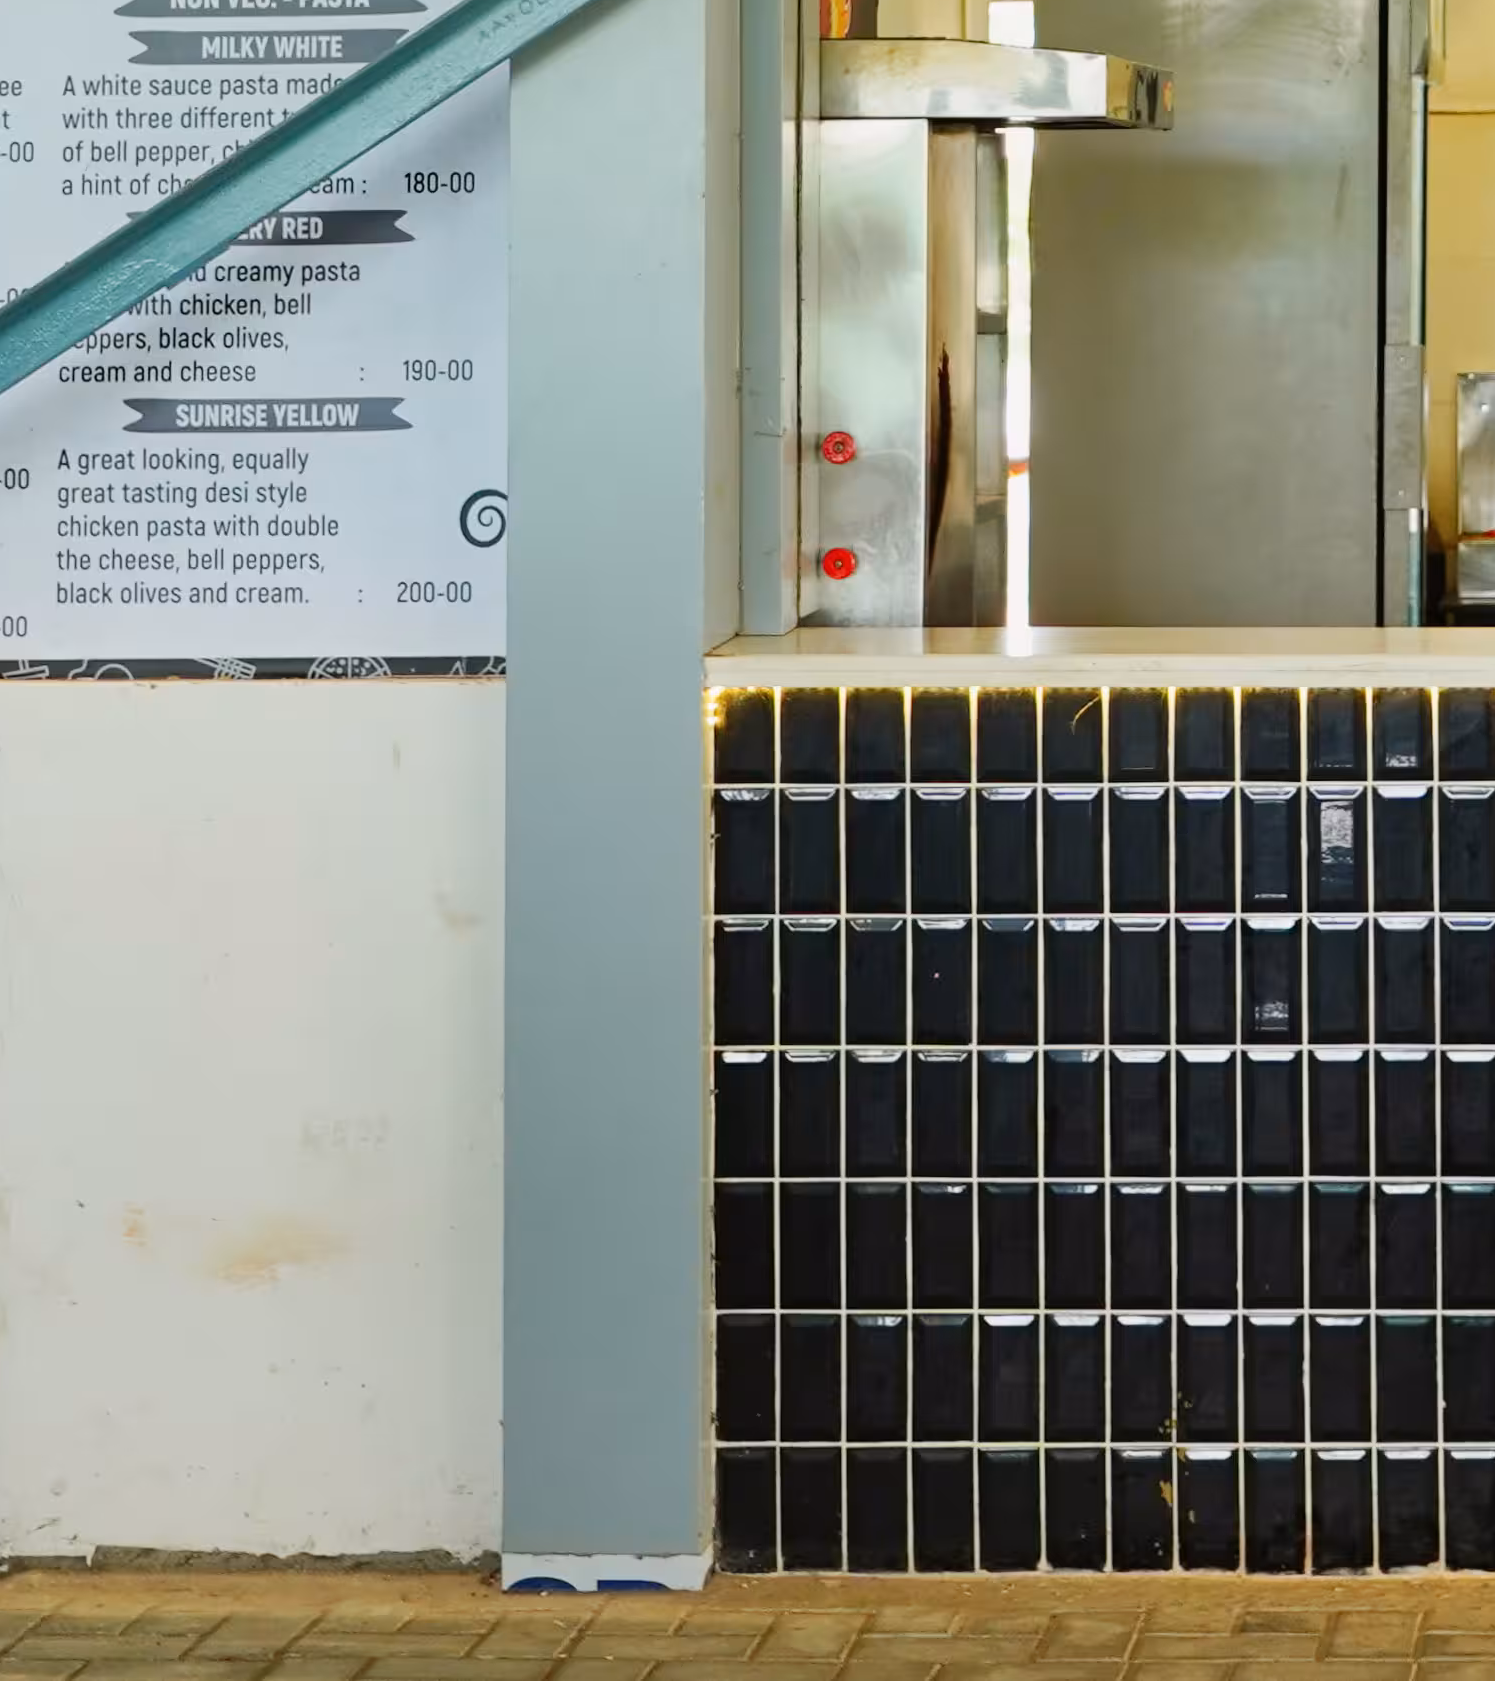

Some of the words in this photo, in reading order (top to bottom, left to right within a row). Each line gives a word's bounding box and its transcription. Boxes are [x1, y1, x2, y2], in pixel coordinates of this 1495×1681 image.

[175, 403, 268, 428] SUNRISE
[272, 403, 360, 427] YELLOW
[57, 514, 139, 537] chicken
[147, 516, 206, 542] pasta
[213, 514, 259, 537] with
[267, 514, 339, 537] double
[396, 580, 472, 603] 200-00
